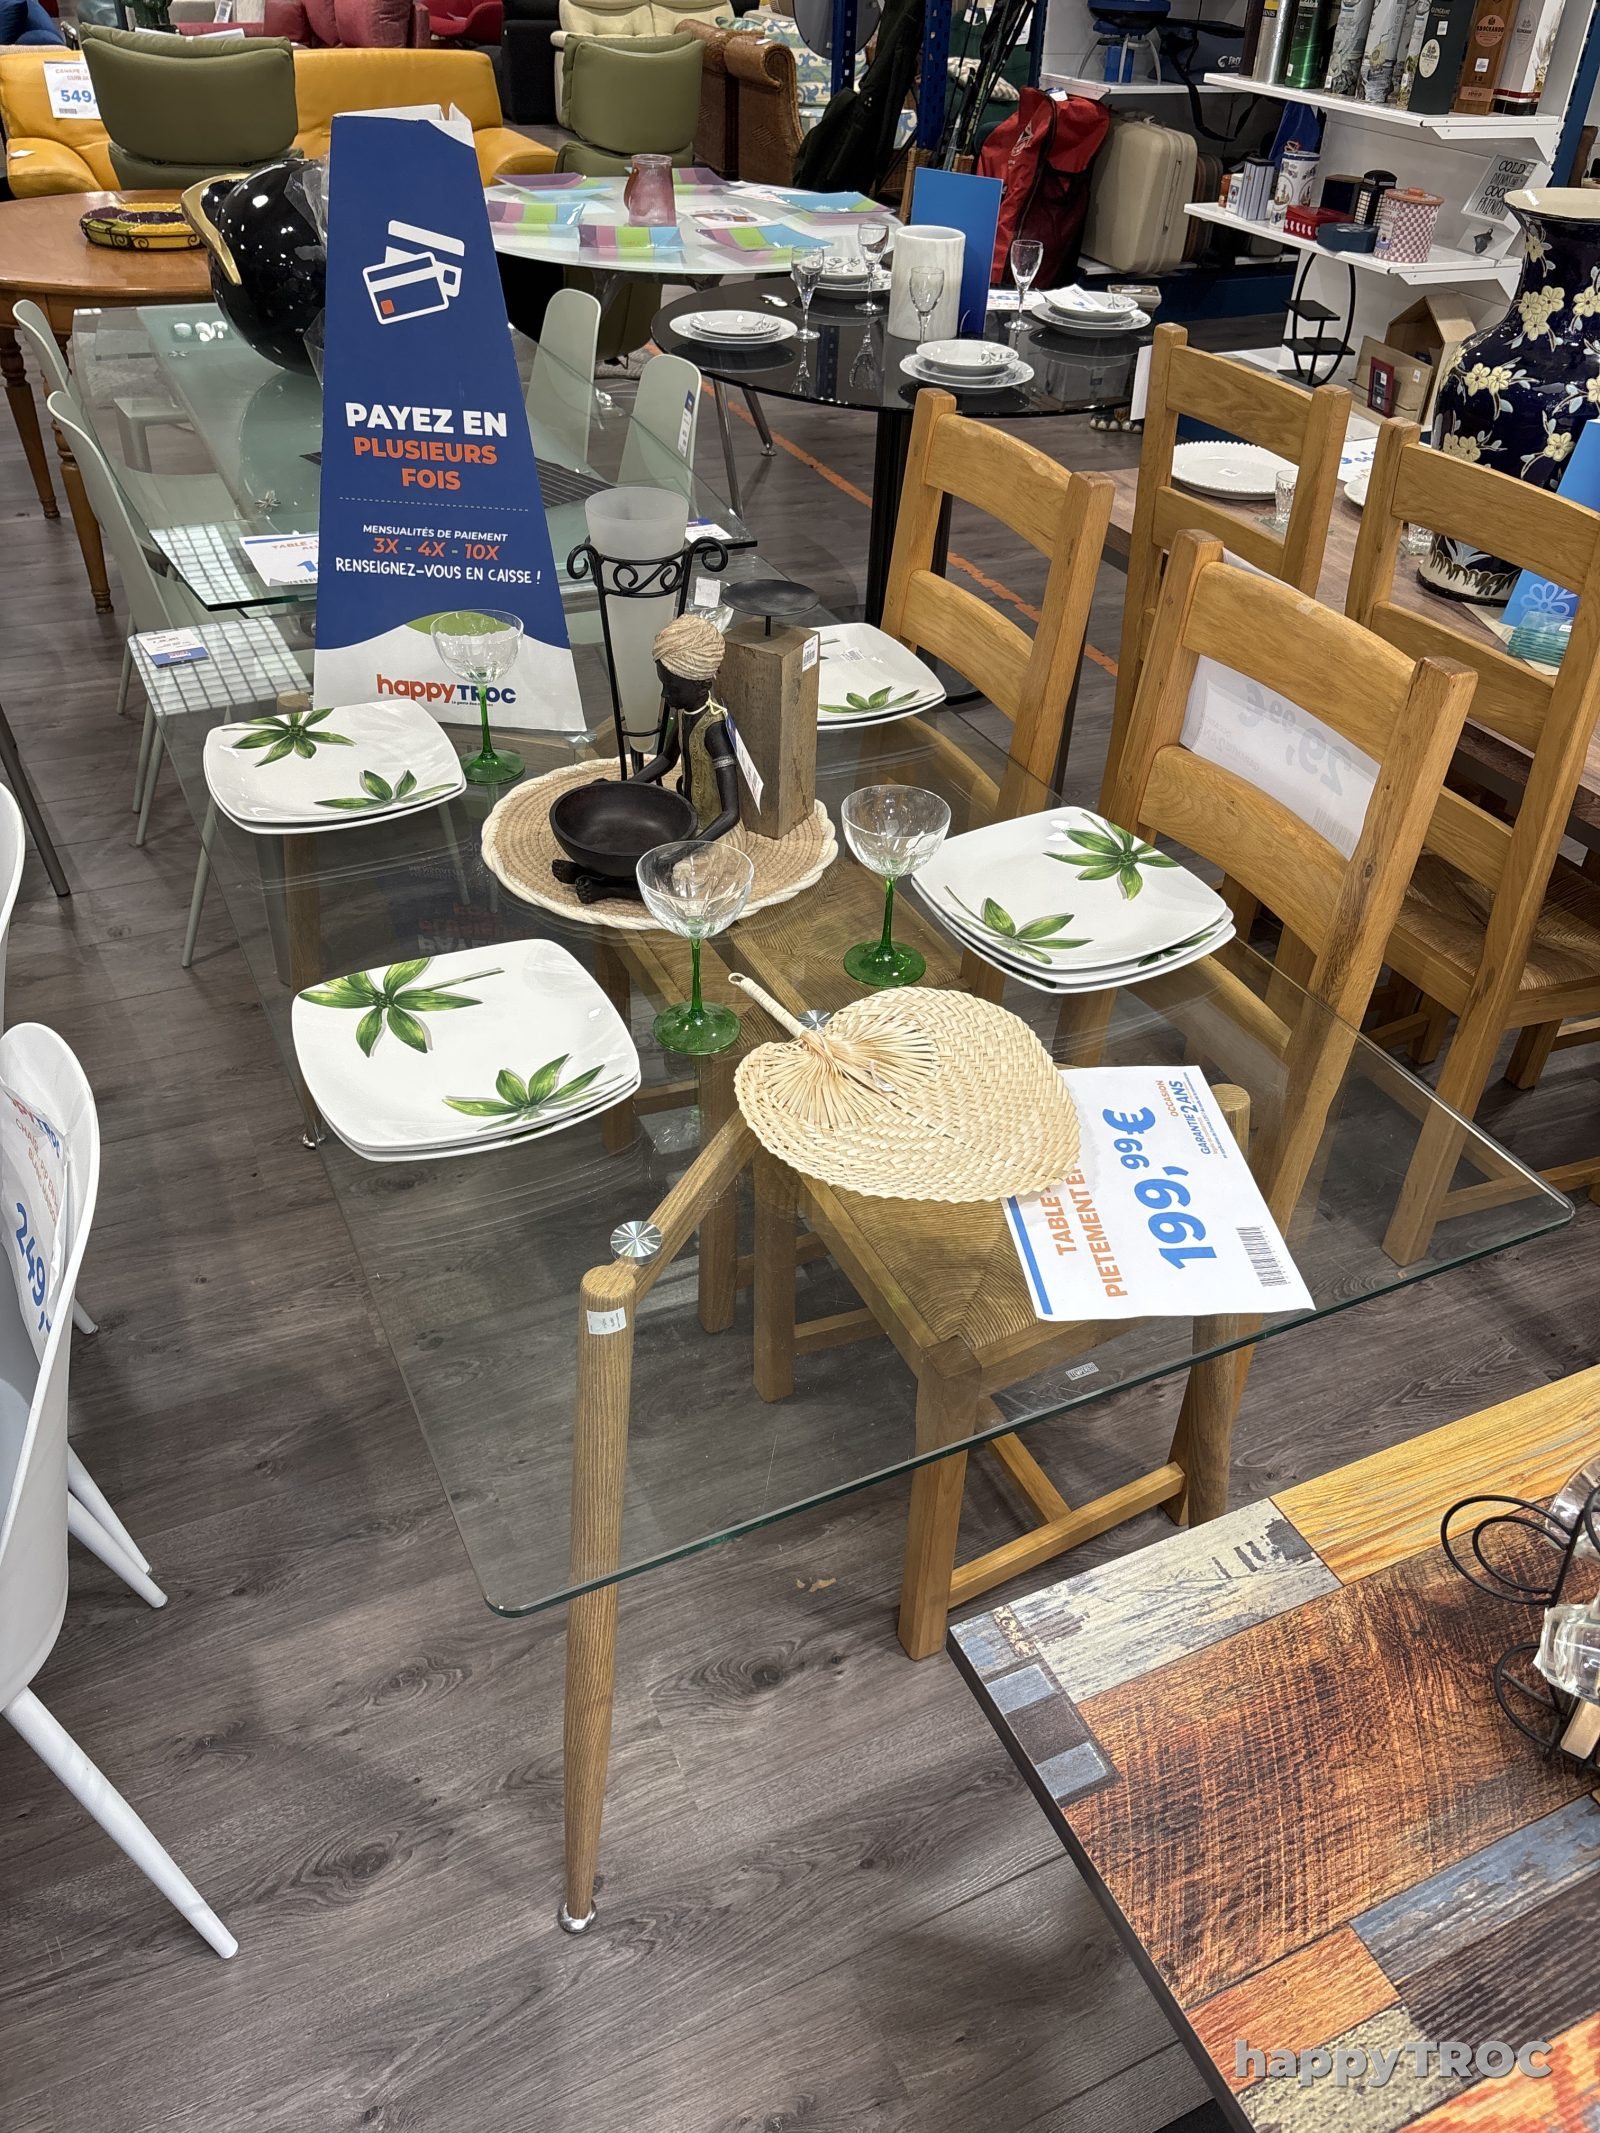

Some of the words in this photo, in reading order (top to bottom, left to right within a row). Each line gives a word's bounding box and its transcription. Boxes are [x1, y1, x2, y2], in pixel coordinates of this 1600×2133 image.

[1498, 160, 1527, 175] COLD
[345, 402, 454, 434] PAYEZ
[462, 410, 508, 437] EN
[353, 437, 498, 465] PLUSIEURS
[401, 468, 461, 490] FOIS
[363, 524, 435, 538] MENSUALITÉS
[437, 529, 452, 539] DE
[454, 531, 508, 542] PAIEMENT
[373, 537, 400, 554] 3X
[417, 541, 446, 558] 4X
[464, 543, 500, 561] 10X
[335, 557, 462, 580] RENSEIGNEZ-VOUS
[465, 566, 484, 581] EN
[488, 568, 533, 584] CAISSE
[1155, 1080, 1179, 1117] OCCASION
[1168, 1080, 1192, 1104] ANS
[1180, 1104, 1199, 1113] 2
[1183, 1113, 1211, 1154] GARANTIE
[1039, 1193, 1077, 1255] TABLE
[1066, 1189, 1128, 1297] PIETEMENT
